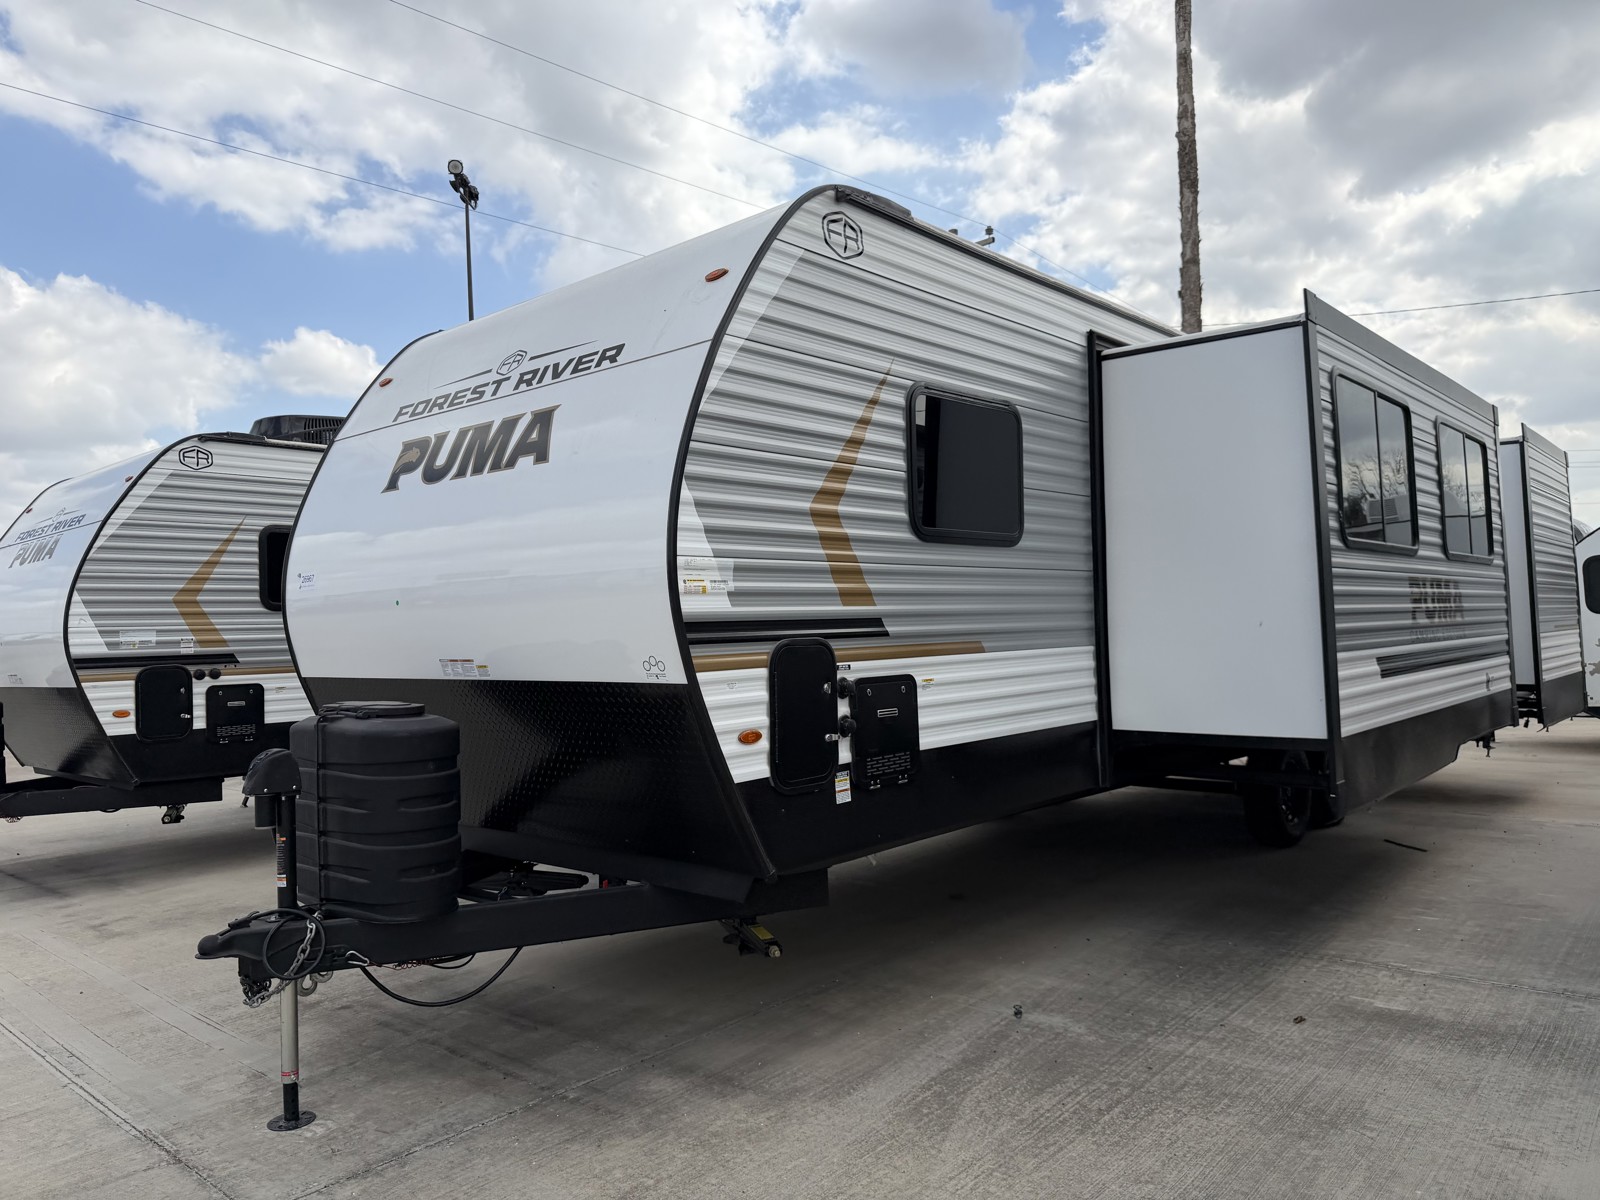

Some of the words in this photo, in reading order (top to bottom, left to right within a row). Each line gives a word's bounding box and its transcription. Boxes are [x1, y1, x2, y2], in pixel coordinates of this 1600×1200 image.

[392, 376, 511, 423] FOREST
[512, 343, 626, 392] RIVER
[381, 404, 562, 493] PUMA
[15, 523, 55, 542] FOREST
[51, 514, 87, 532] RIVER
[8, 533, 64, 569] PUMA
[1407, 576, 1465, 621] PUMA
